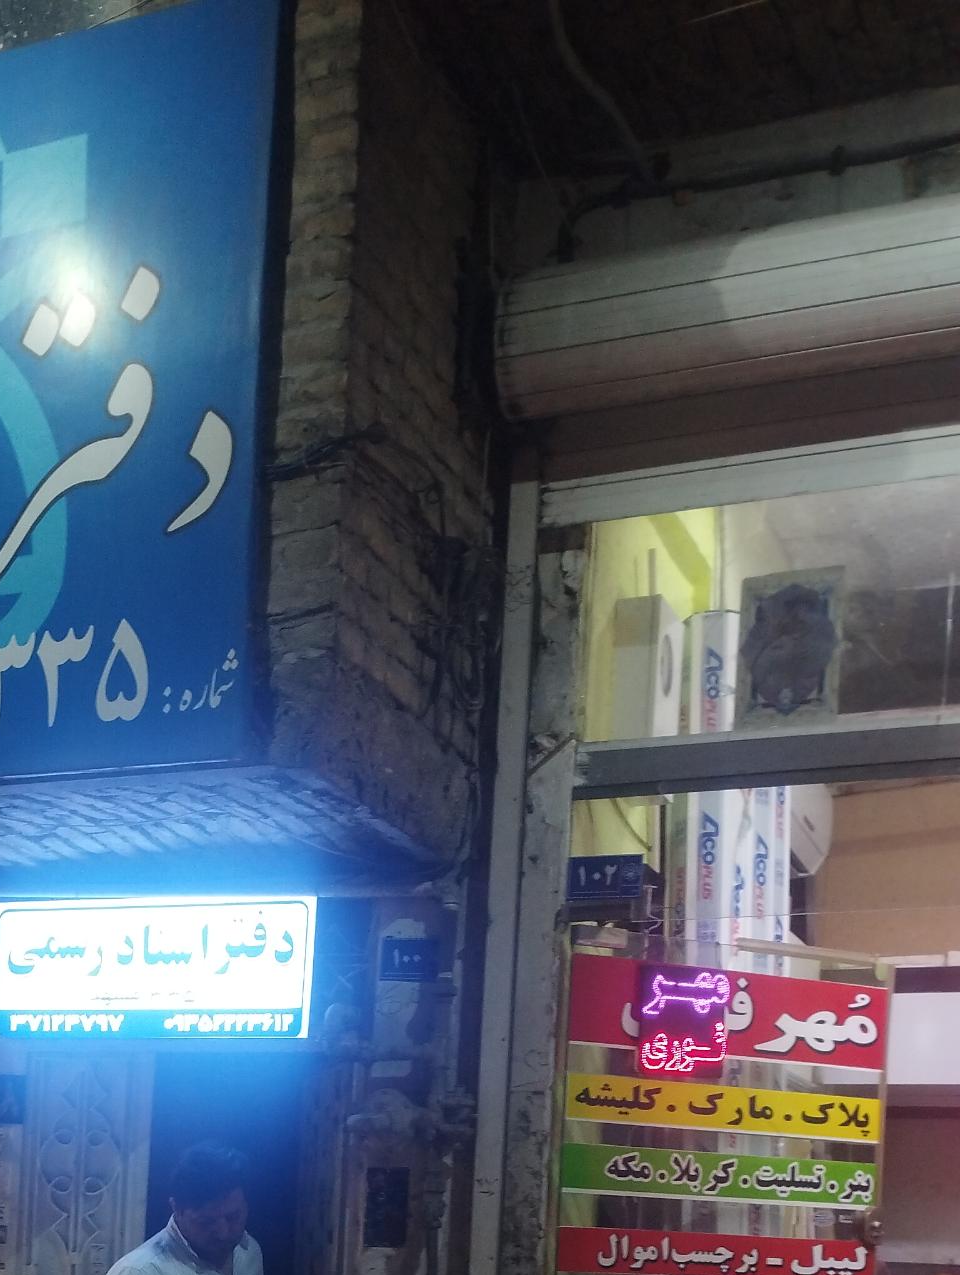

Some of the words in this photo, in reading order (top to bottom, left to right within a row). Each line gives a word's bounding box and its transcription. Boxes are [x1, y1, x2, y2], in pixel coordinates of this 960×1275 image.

[8, 936, 103, 976] رسمی
[116, 923, 209, 966] اسناد
[214, 910, 294, 975] دفتر
[575, 1083, 662, 1115] کلیشه
[687, 1092, 774, 1125] مارک
[801, 1102, 870, 1136] پلاک
[605, 1152, 652, 1179] مکه
[672, 1155, 736, 1193] کربلا
[755, 1163, 824, 1196] تسلیت
[843, 1171, 873, 1201] بنر
[597, 1233, 670, 1268] اموال
[671, 1244, 759, 1273] برچسب
[791, 1244, 868, 1275] لیبل
